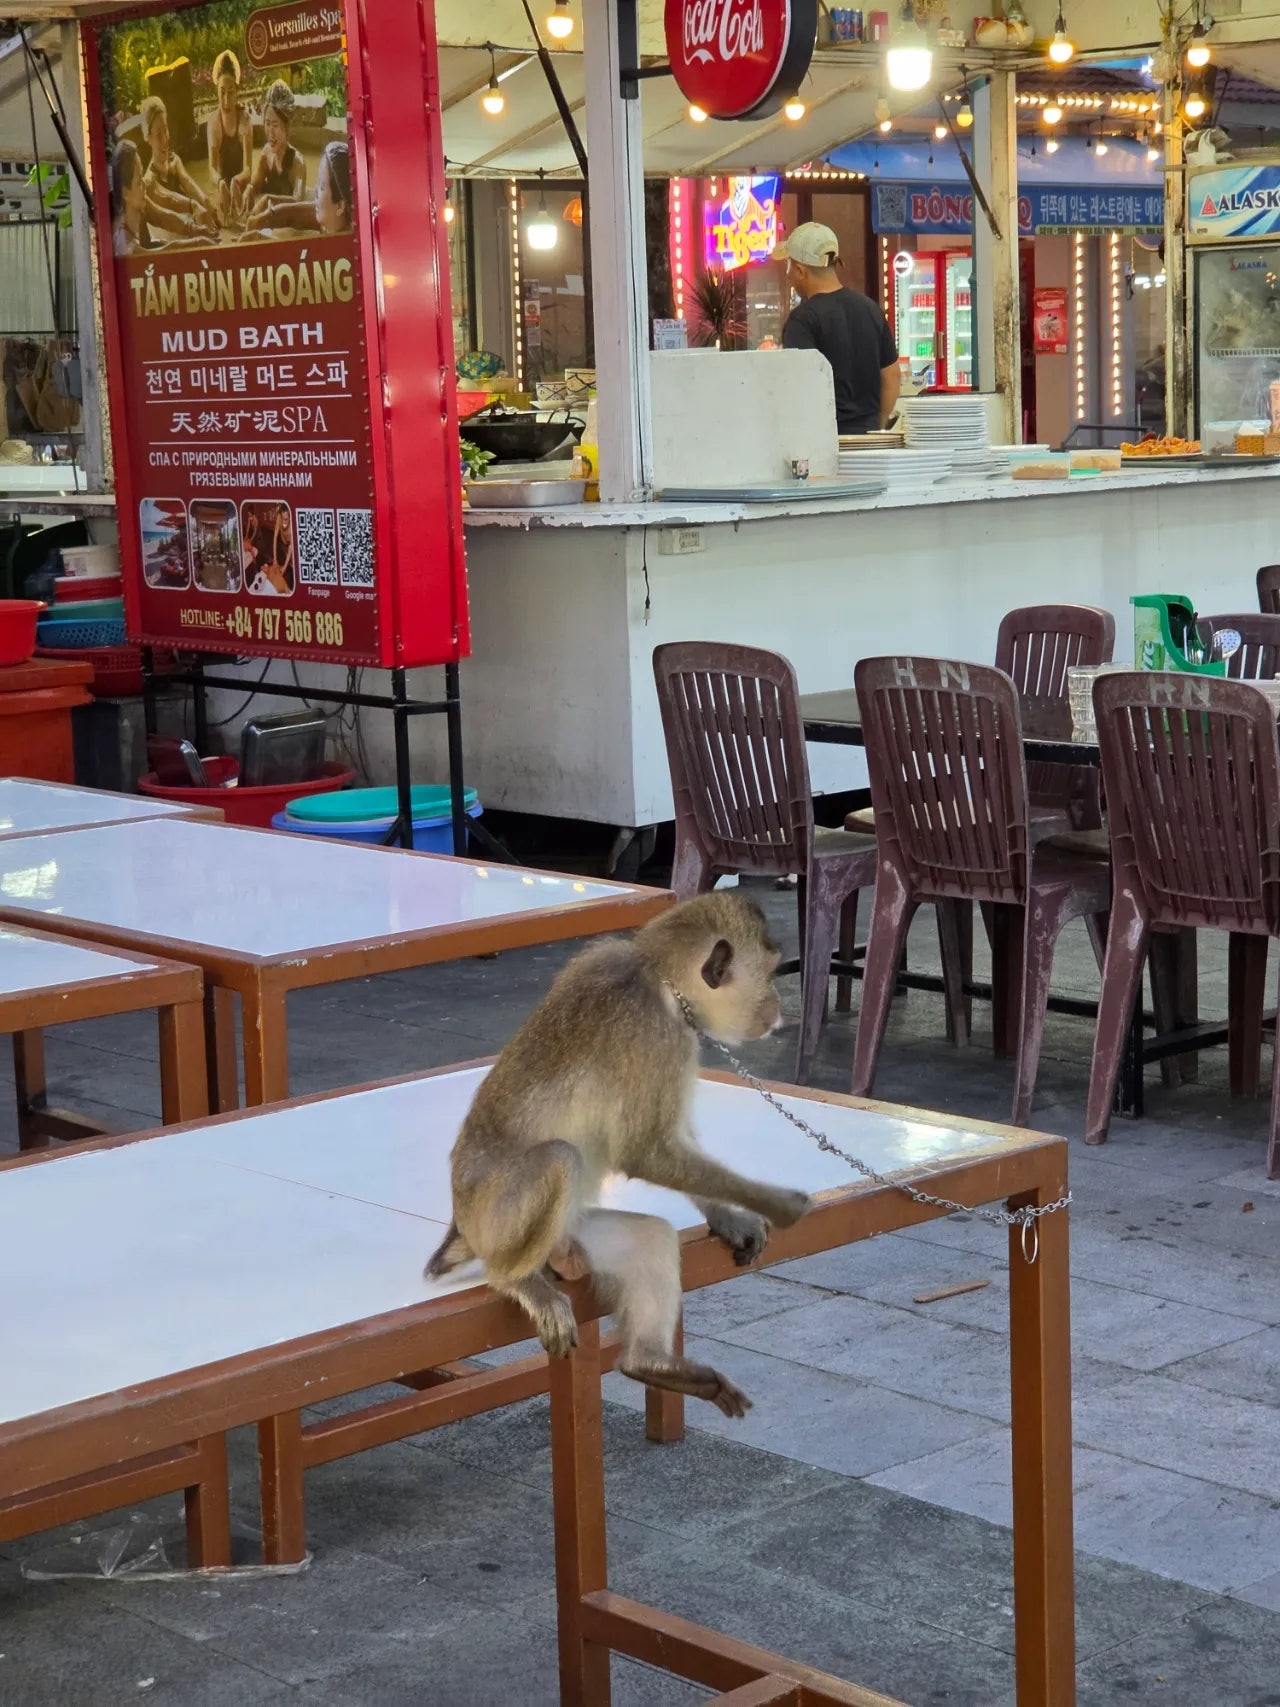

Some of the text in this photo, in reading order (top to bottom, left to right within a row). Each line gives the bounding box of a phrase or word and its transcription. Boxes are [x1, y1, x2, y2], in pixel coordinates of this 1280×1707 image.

[268, 8, 341, 38] Versailles Spa
[1070, 195, 1087, 222] 있는
[1145, 196, 1163, 223] 에어
[1219, 189, 1280, 212] ALASK
[713, 221, 772, 265] Tiger
[130, 249, 354, 317] TẮM BÙN KHOÁNG
[162, 322, 324, 353] MUD BATH
[146, 360, 349, 394] 천연 미네랄 머드 스파
[149, 451, 357, 469] СПА С ПРИРОДНЫМИ МИНЕРАЛЬНЫМИ
[190, 472, 313, 488] ГРЯЗЕВЫМИ ВАННАМИ
[308, 586, 331, 599] Fanpage
[345, 590, 375, 602] Google ma
[180, 605, 344, 647] HOTLINE: +84 797 566 886
